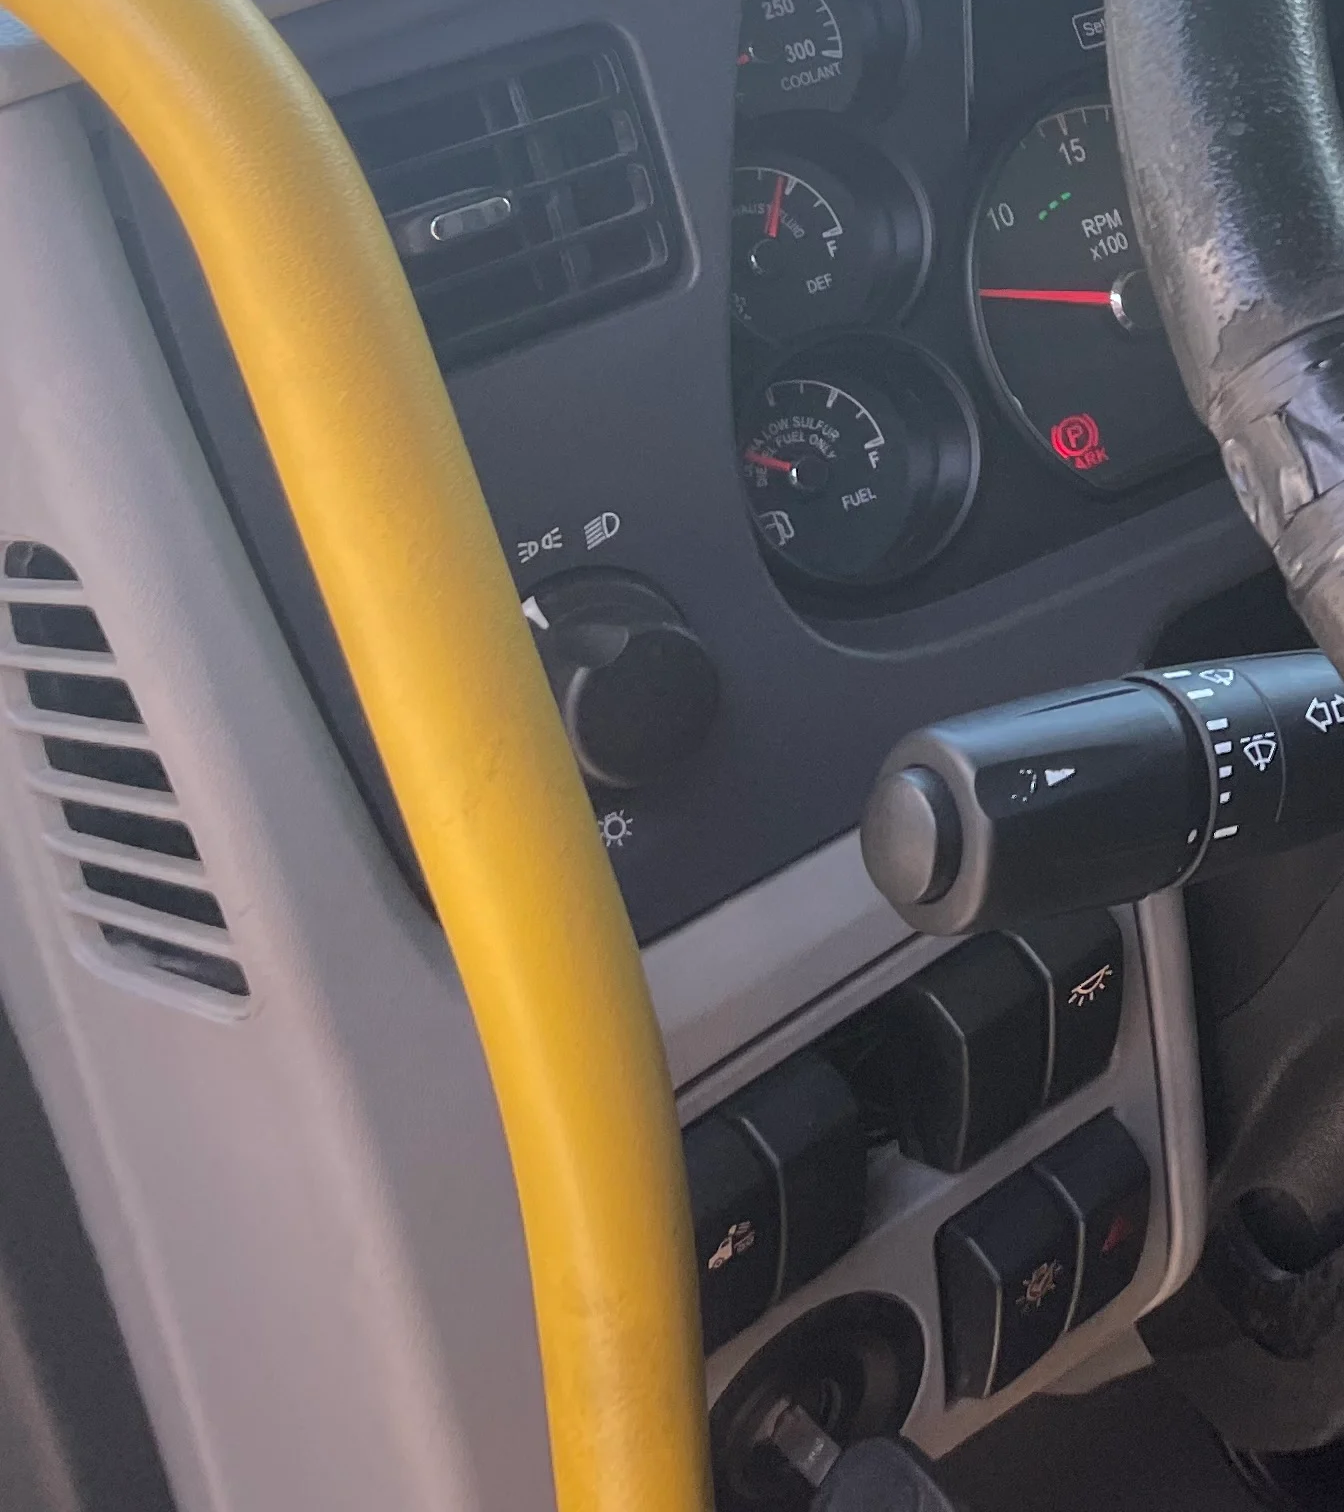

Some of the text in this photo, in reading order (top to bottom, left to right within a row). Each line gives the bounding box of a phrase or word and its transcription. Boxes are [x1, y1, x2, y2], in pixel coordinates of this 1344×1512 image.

[784, 38, 817, 64] 300
[781, 61, 842, 92] COOLANT
[1059, 137, 1086, 165] 15
[986, 202, 1015, 231] 10
[1081, 208, 1124, 238] RPM
[826, 240, 838, 258] F
[1089, 231, 1129, 261] x100
[806, 273, 833, 294] DEF
[792, 416, 841, 443] SULFUR
[776, 431, 805, 448] FUEL
[808, 433, 837, 459] ONLY
[867, 450, 880, 469] F
[841, 487, 877, 512] FUEL
